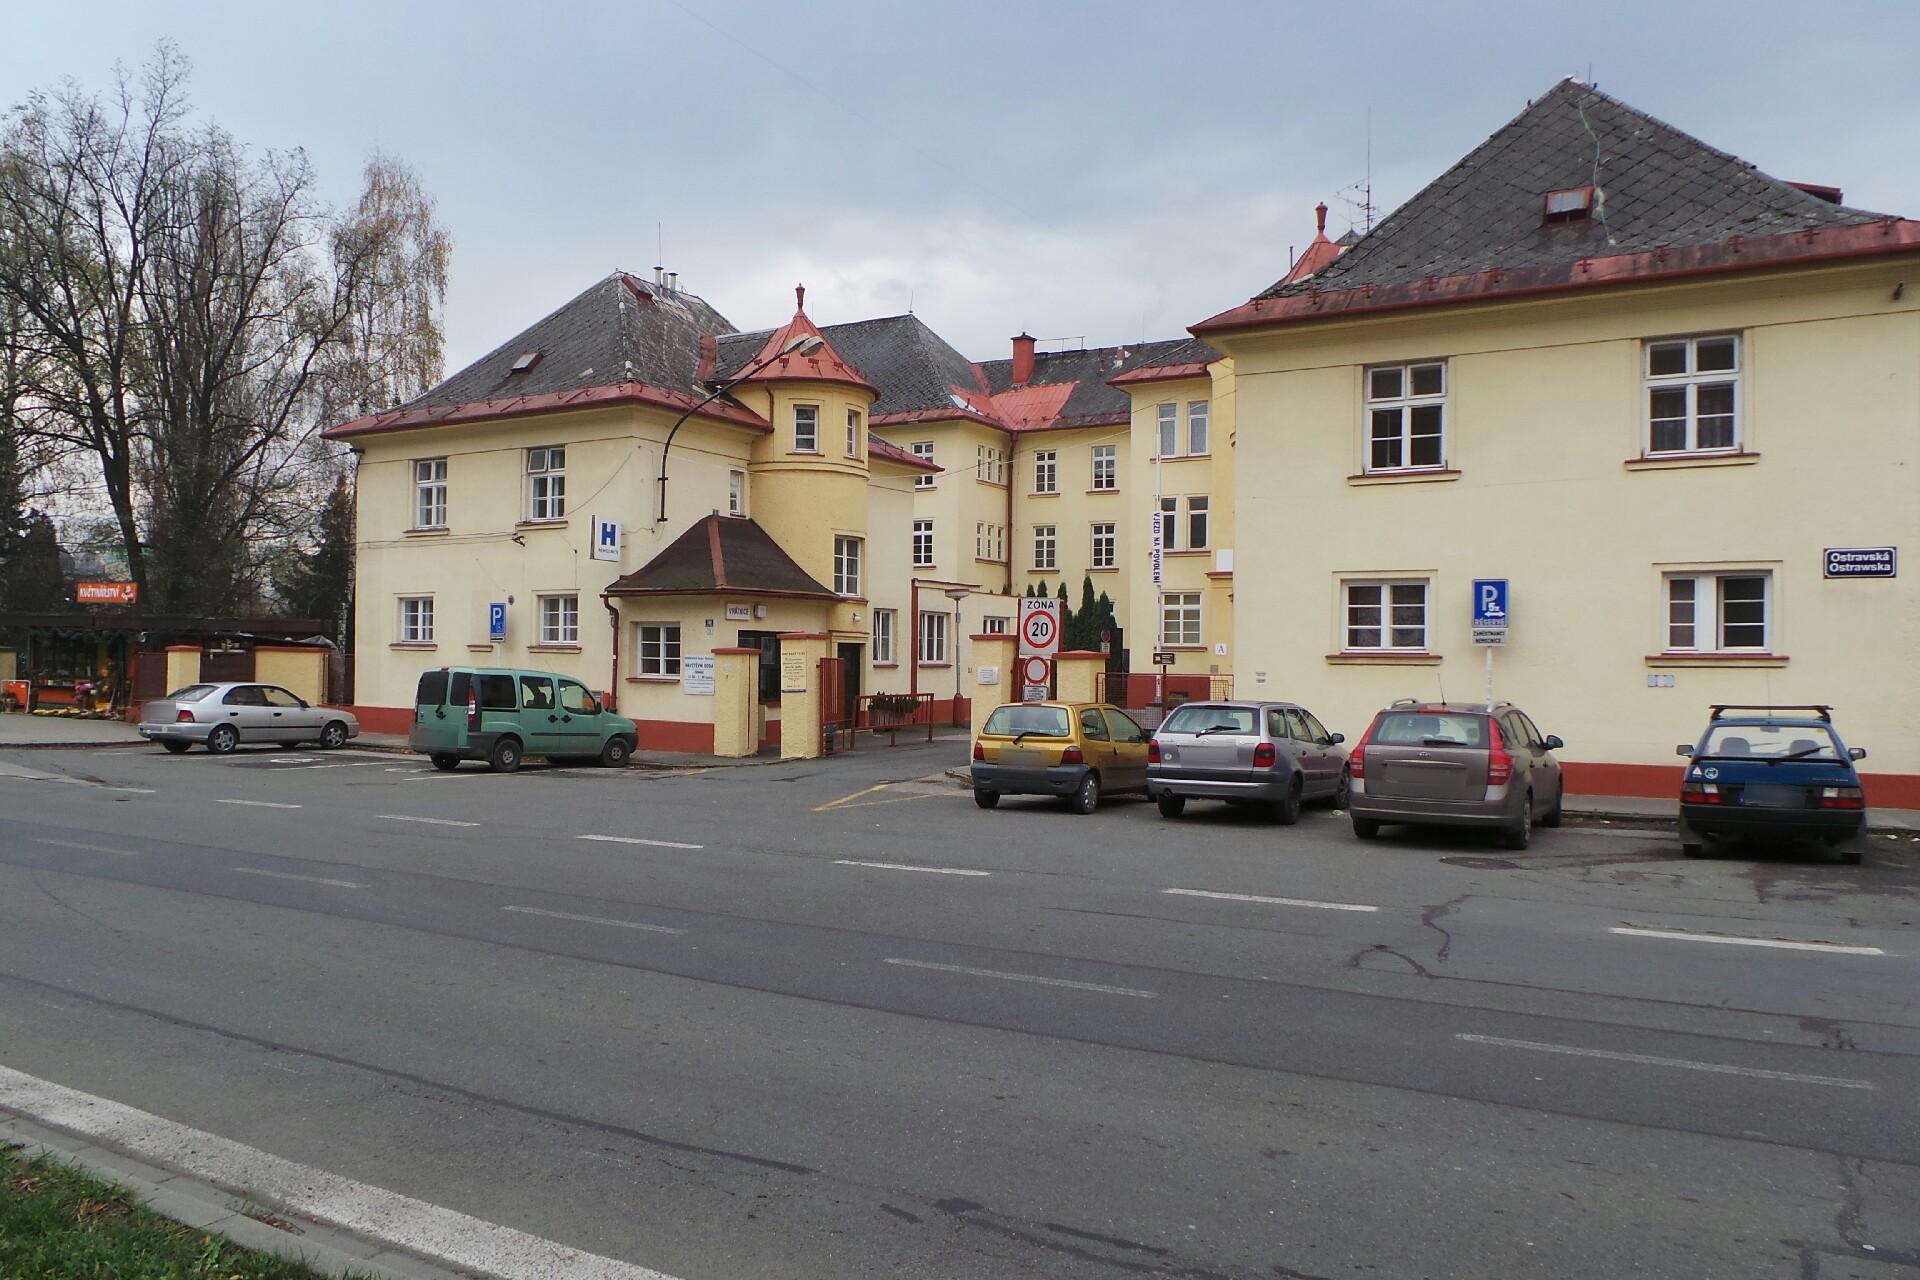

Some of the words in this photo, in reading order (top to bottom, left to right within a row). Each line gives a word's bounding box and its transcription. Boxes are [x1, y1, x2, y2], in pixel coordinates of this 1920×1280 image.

[1153, 512, 1161, 534] VJEZD
[601, 522, 616, 546] H
[1153, 537, 1161, 547] NA
[1830, 552, 1890, 562] Ostravská
[1829, 563, 1891, 572] Ostrawska
[1027, 599, 1054, 609] ZÓNA
[1482, 585, 1499, 611] P
[493, 607, 502, 626] P
[1032, 622, 1049, 637] 20
